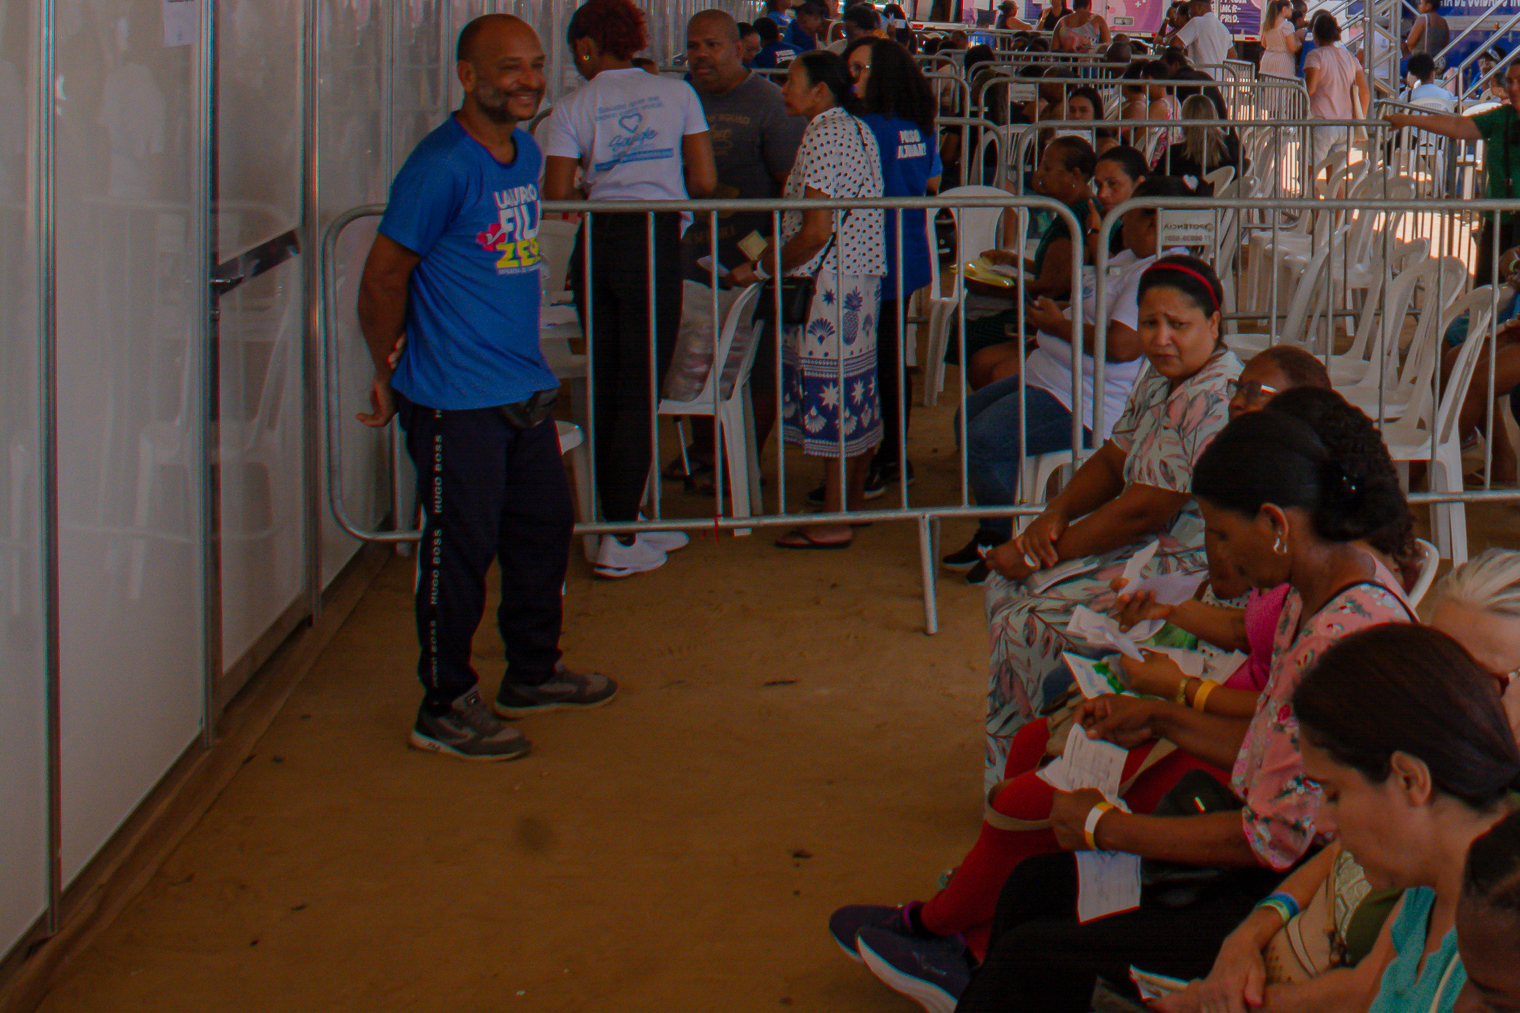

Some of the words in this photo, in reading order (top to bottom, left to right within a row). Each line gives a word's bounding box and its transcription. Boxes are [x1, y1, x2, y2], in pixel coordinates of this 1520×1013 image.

[494, 183, 538, 209] LAURO
[434, 434, 443, 472] BOSS
[434, 476, 443, 514] HUGO
[432, 529, 442, 565] BOSS
[431, 569, 440, 606] HUGO
